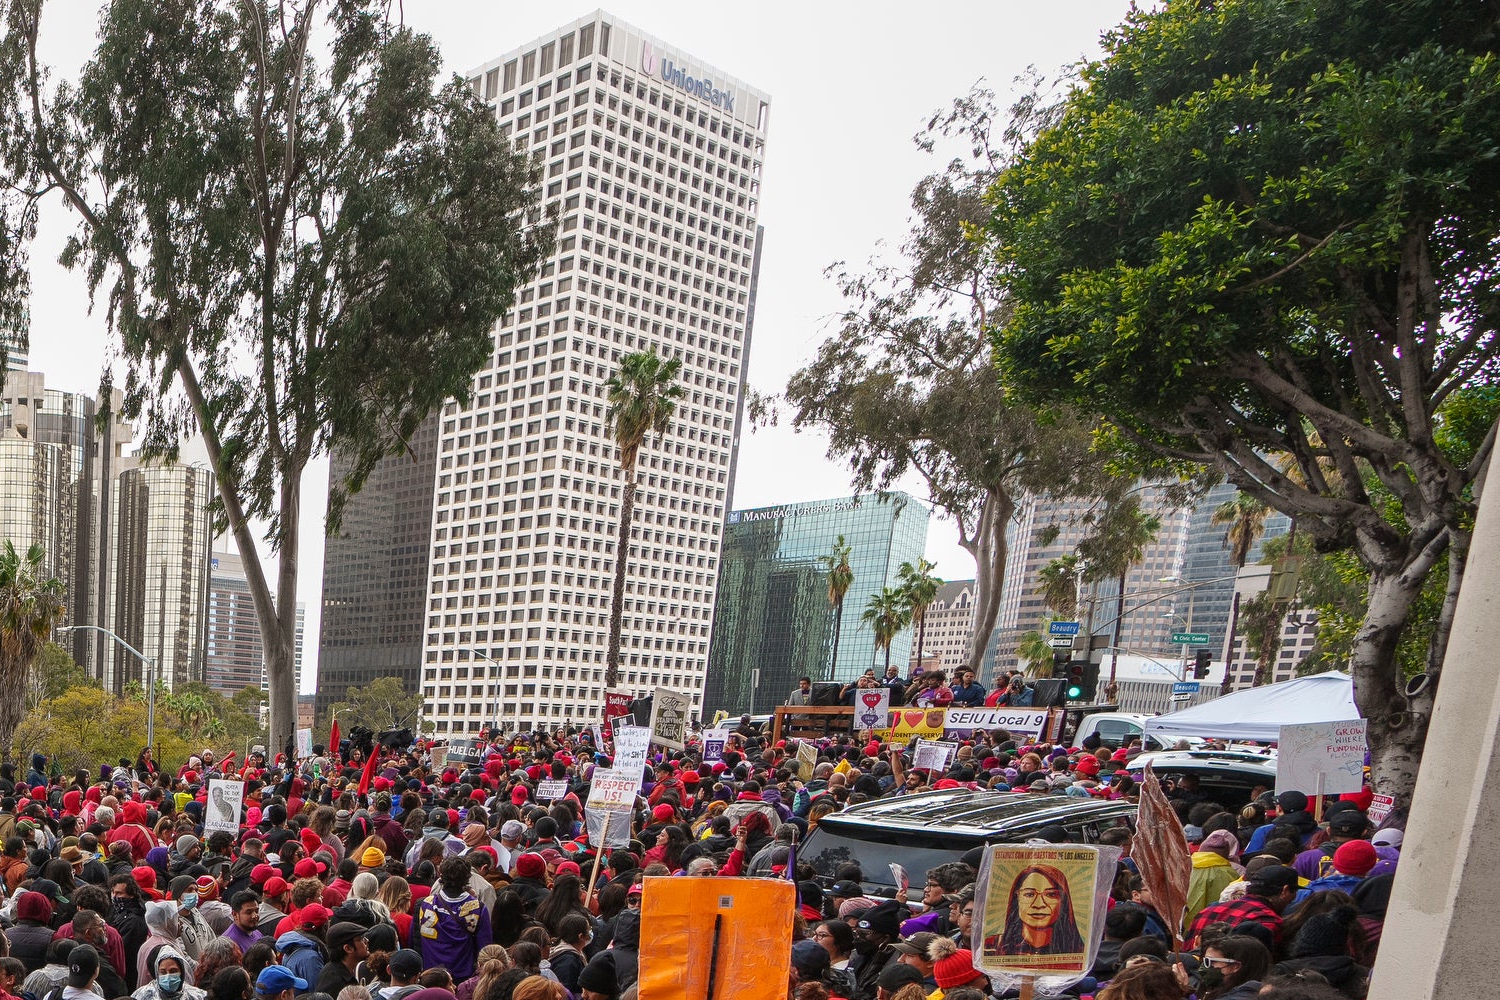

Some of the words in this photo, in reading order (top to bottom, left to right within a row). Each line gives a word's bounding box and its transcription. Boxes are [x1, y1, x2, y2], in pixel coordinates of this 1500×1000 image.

[661, 58, 735, 113] UnionBank
[1051, 624, 1077, 633] Beaudry
[1174, 684, 1197, 692] Beaudry
[950, 713, 985, 724] SEIU
[988, 714, 1030, 726] Local
[1335, 728, 1364, 736] GROW
[1335, 735, 1363, 743] WHERE
[448, 744, 481, 758] HUELGA
[1327, 745, 1364, 753] FUNDING
[595, 780, 636, 792] RESPECT
[604, 790, 622, 801] US!
[206, 820, 238, 830] CARVALHO
[1064, 852, 1074, 860] LOS
